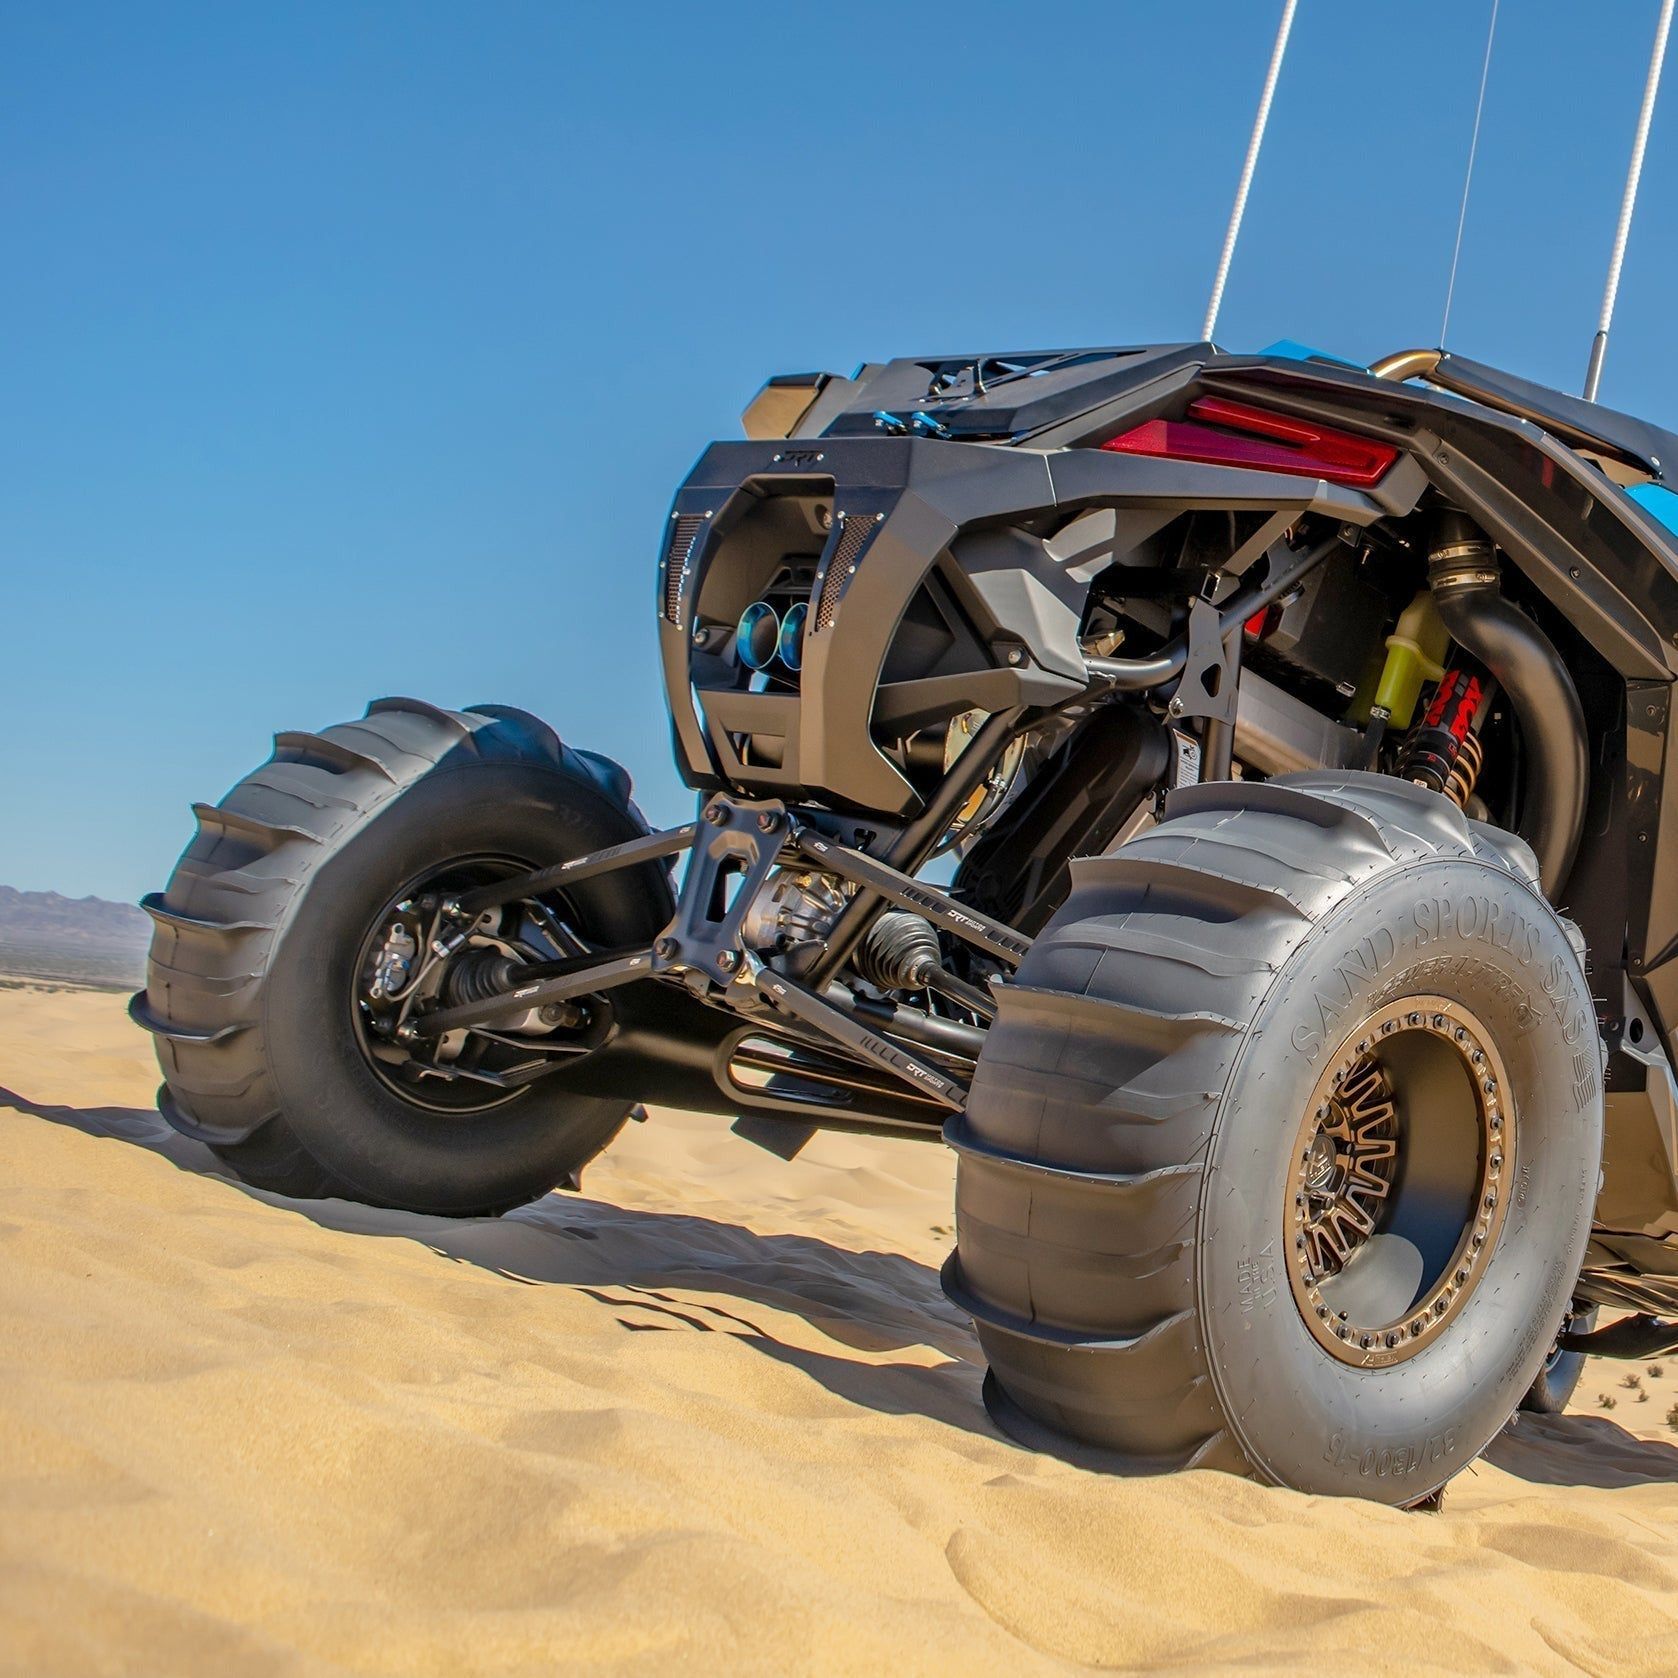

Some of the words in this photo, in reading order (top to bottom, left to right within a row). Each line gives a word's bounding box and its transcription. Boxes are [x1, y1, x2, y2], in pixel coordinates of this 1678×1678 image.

[947, 909, 970, 922] DRT
[1291, 924, 1396, 1066] SAND
[1412, 895, 1541, 966] SPORTS
[1541, 952, 1588, 1046] SXS
[906, 1062, 928, 1077] DRT
[1237, 1257, 1254, 1313] MADE
[1259, 1239, 1277, 1308] USA
